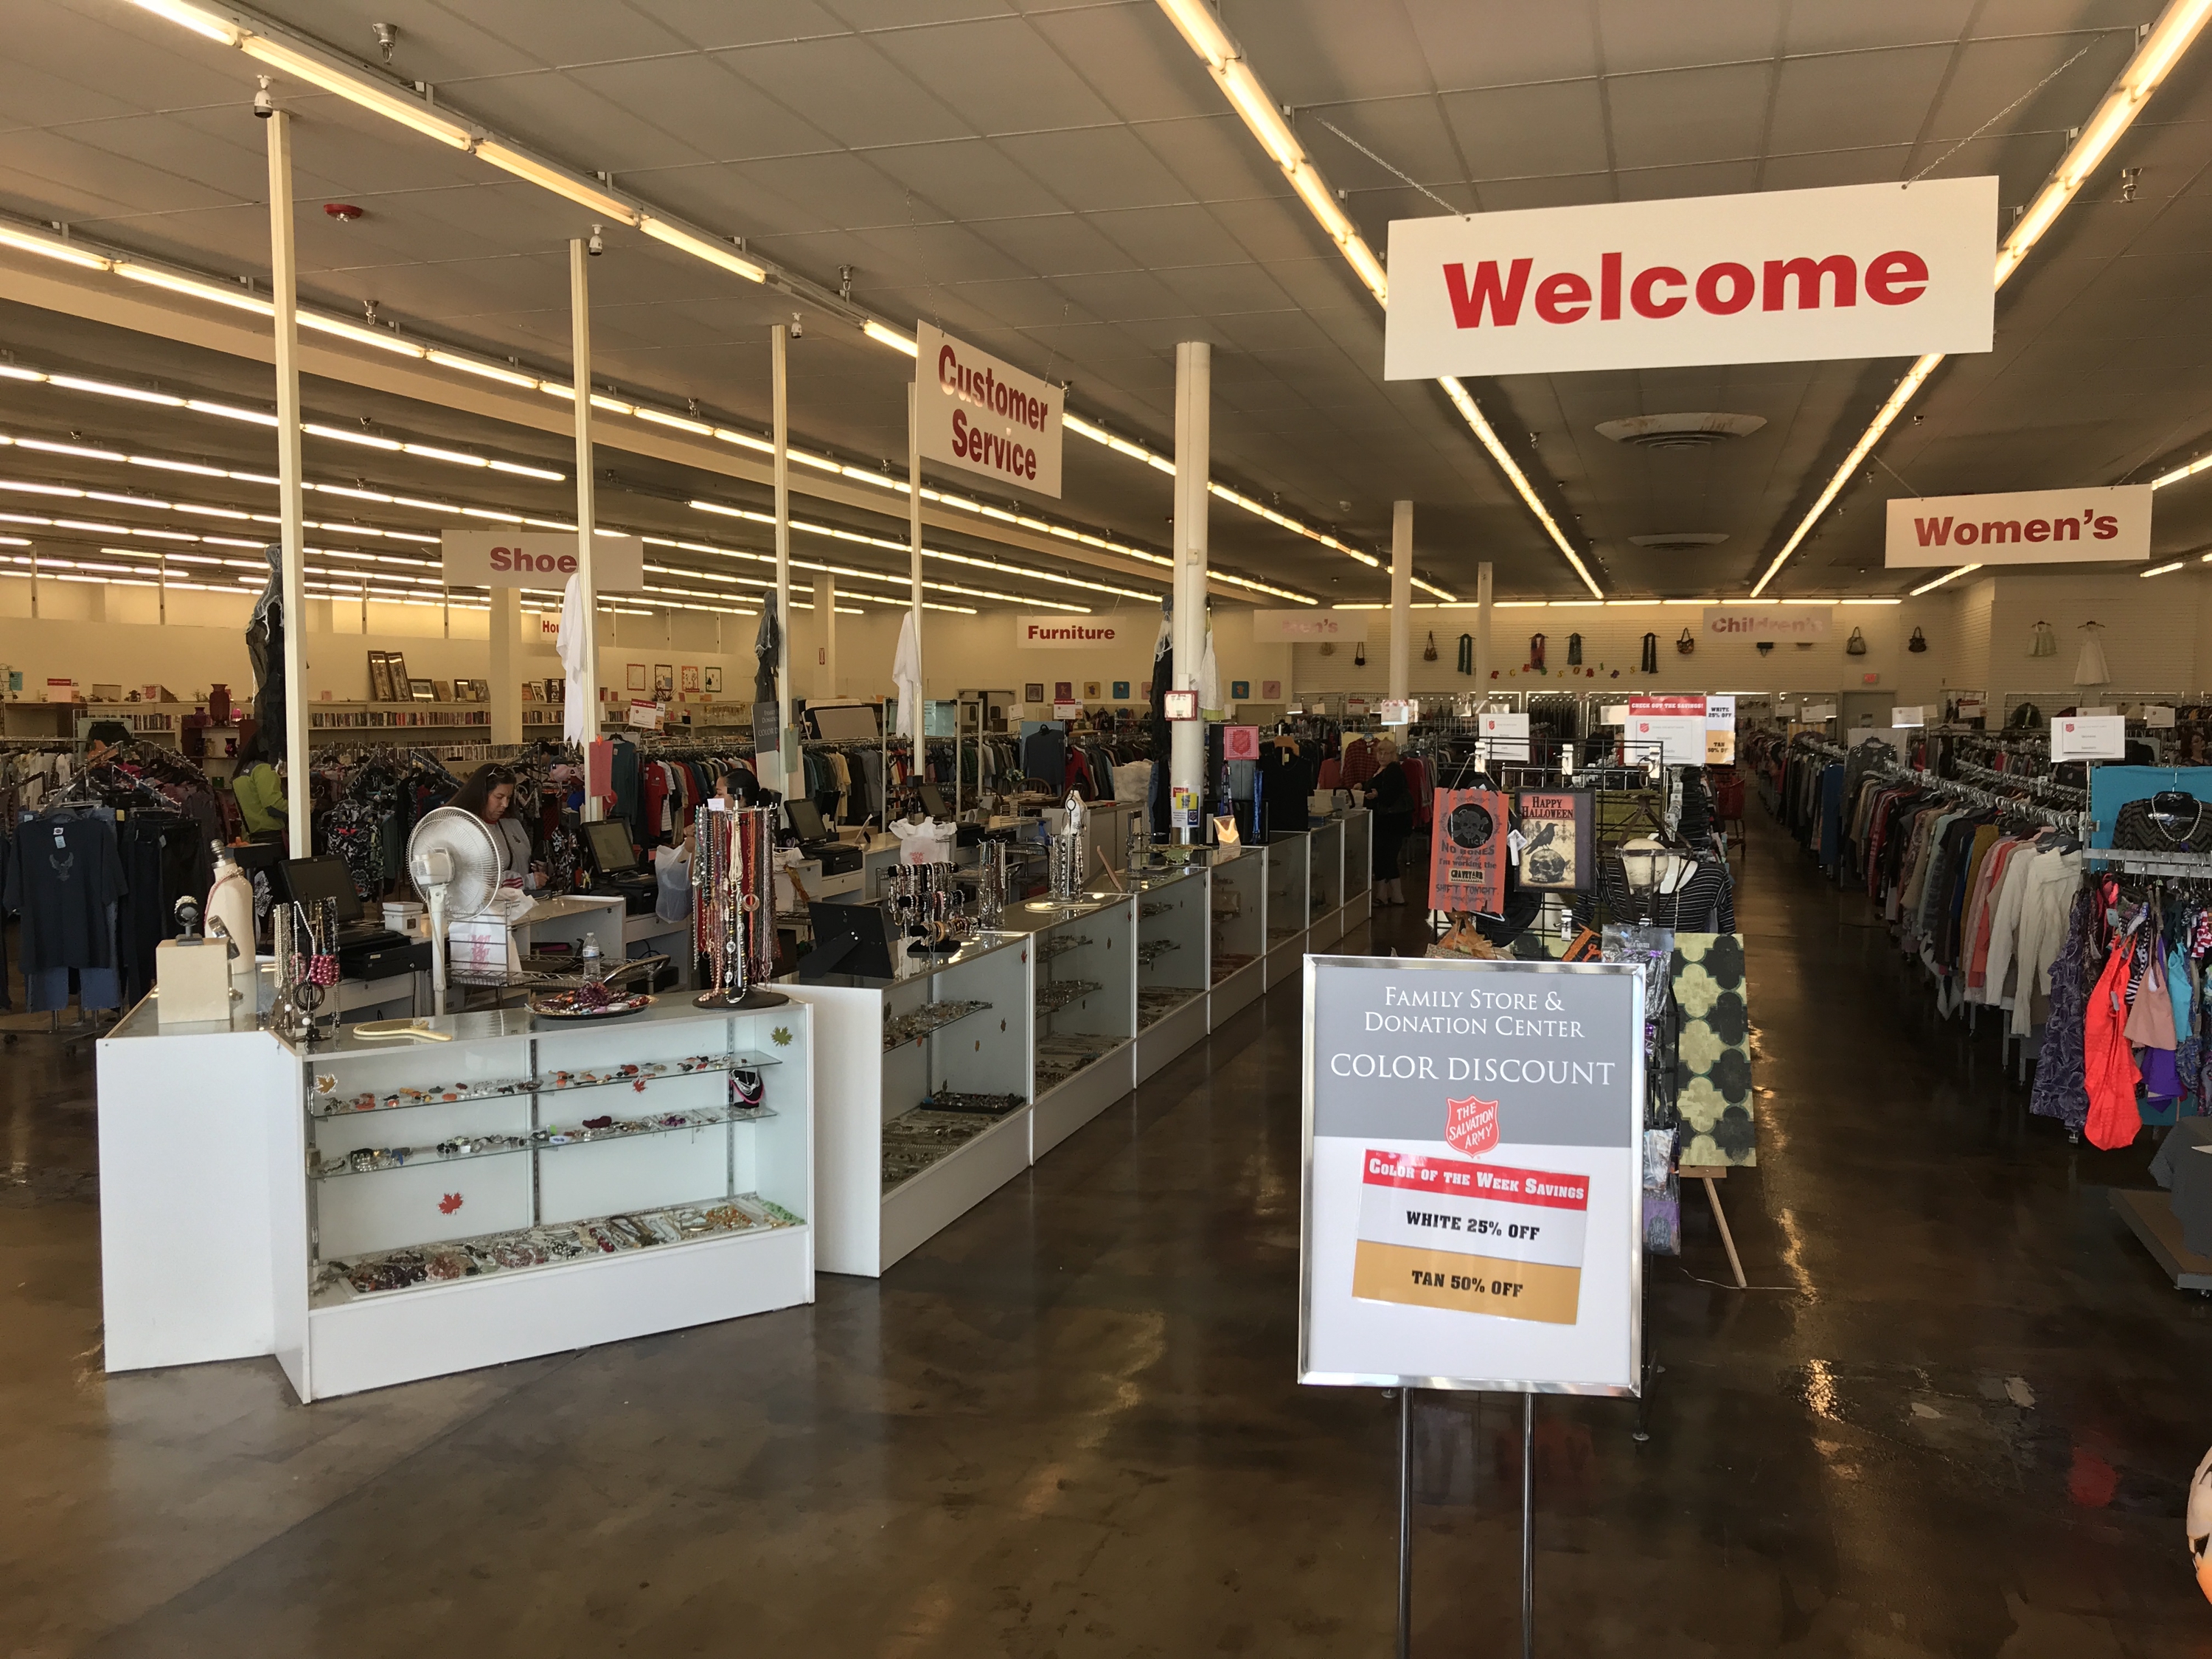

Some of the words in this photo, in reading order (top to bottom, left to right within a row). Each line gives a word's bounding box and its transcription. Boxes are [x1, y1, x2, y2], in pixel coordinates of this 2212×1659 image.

[1443, 249, 1930, 329] Welcome
[939, 344, 1048, 433] Customer
[952, 408, 1037, 481] Service
[1914, 509, 2118, 547] Women's
[490, 546, 577, 573] Shoe
[1028, 625, 1116, 640] Furniture
[1711, 616, 1823, 633] Children's
[1522, 806, 1573, 818] HALLOWEEN
[1532, 796, 1562, 809] HAPPY
[1441, 840, 1456, 853] NO
[1460, 845, 1495, 855] BONES
[1439, 858, 1450, 866] I'm
[1453, 860, 1482, 869] working
[1484, 861, 1497, 869] the
[1451, 869, 1484, 880] GRAVEYARD
[1436, 884, 1460, 893] SHIFT
[1385, 986, 1464, 1009] FAMILY
[1470, 989, 1537, 1010] STORE
[1545, 991, 1565, 1011] &
[1365, 1011, 1487, 1035] DONATION
[1495, 1016, 1585, 1038] CENTER
[1330, 1053, 1439, 1079] COLOR
[1447, 1057, 1615, 1085] DISCOUNT
[1449, 1105, 1494, 1141] SALVATION
[1456, 1102, 1477, 1121] THE
[1464, 1122, 1492, 1150] ARMY
[1368, 1158, 1415, 1179] COLOR
[1421, 1170, 1438, 1181] OF
[1443, 1172, 1470, 1186] THE
[1476, 1172, 1519, 1192] WEEK
[1524, 1178, 1585, 1200] SAVINGS
[1405, 1210, 1461, 1231] WHITE
[1467, 1218, 1502, 1237] 25%
[1508, 1224, 1540, 1240] OFF
[1411, 1270, 1445, 1288] TAN
[1450, 1276, 1485, 1293] 50%
[1491, 1280, 1523, 1298] OFF
